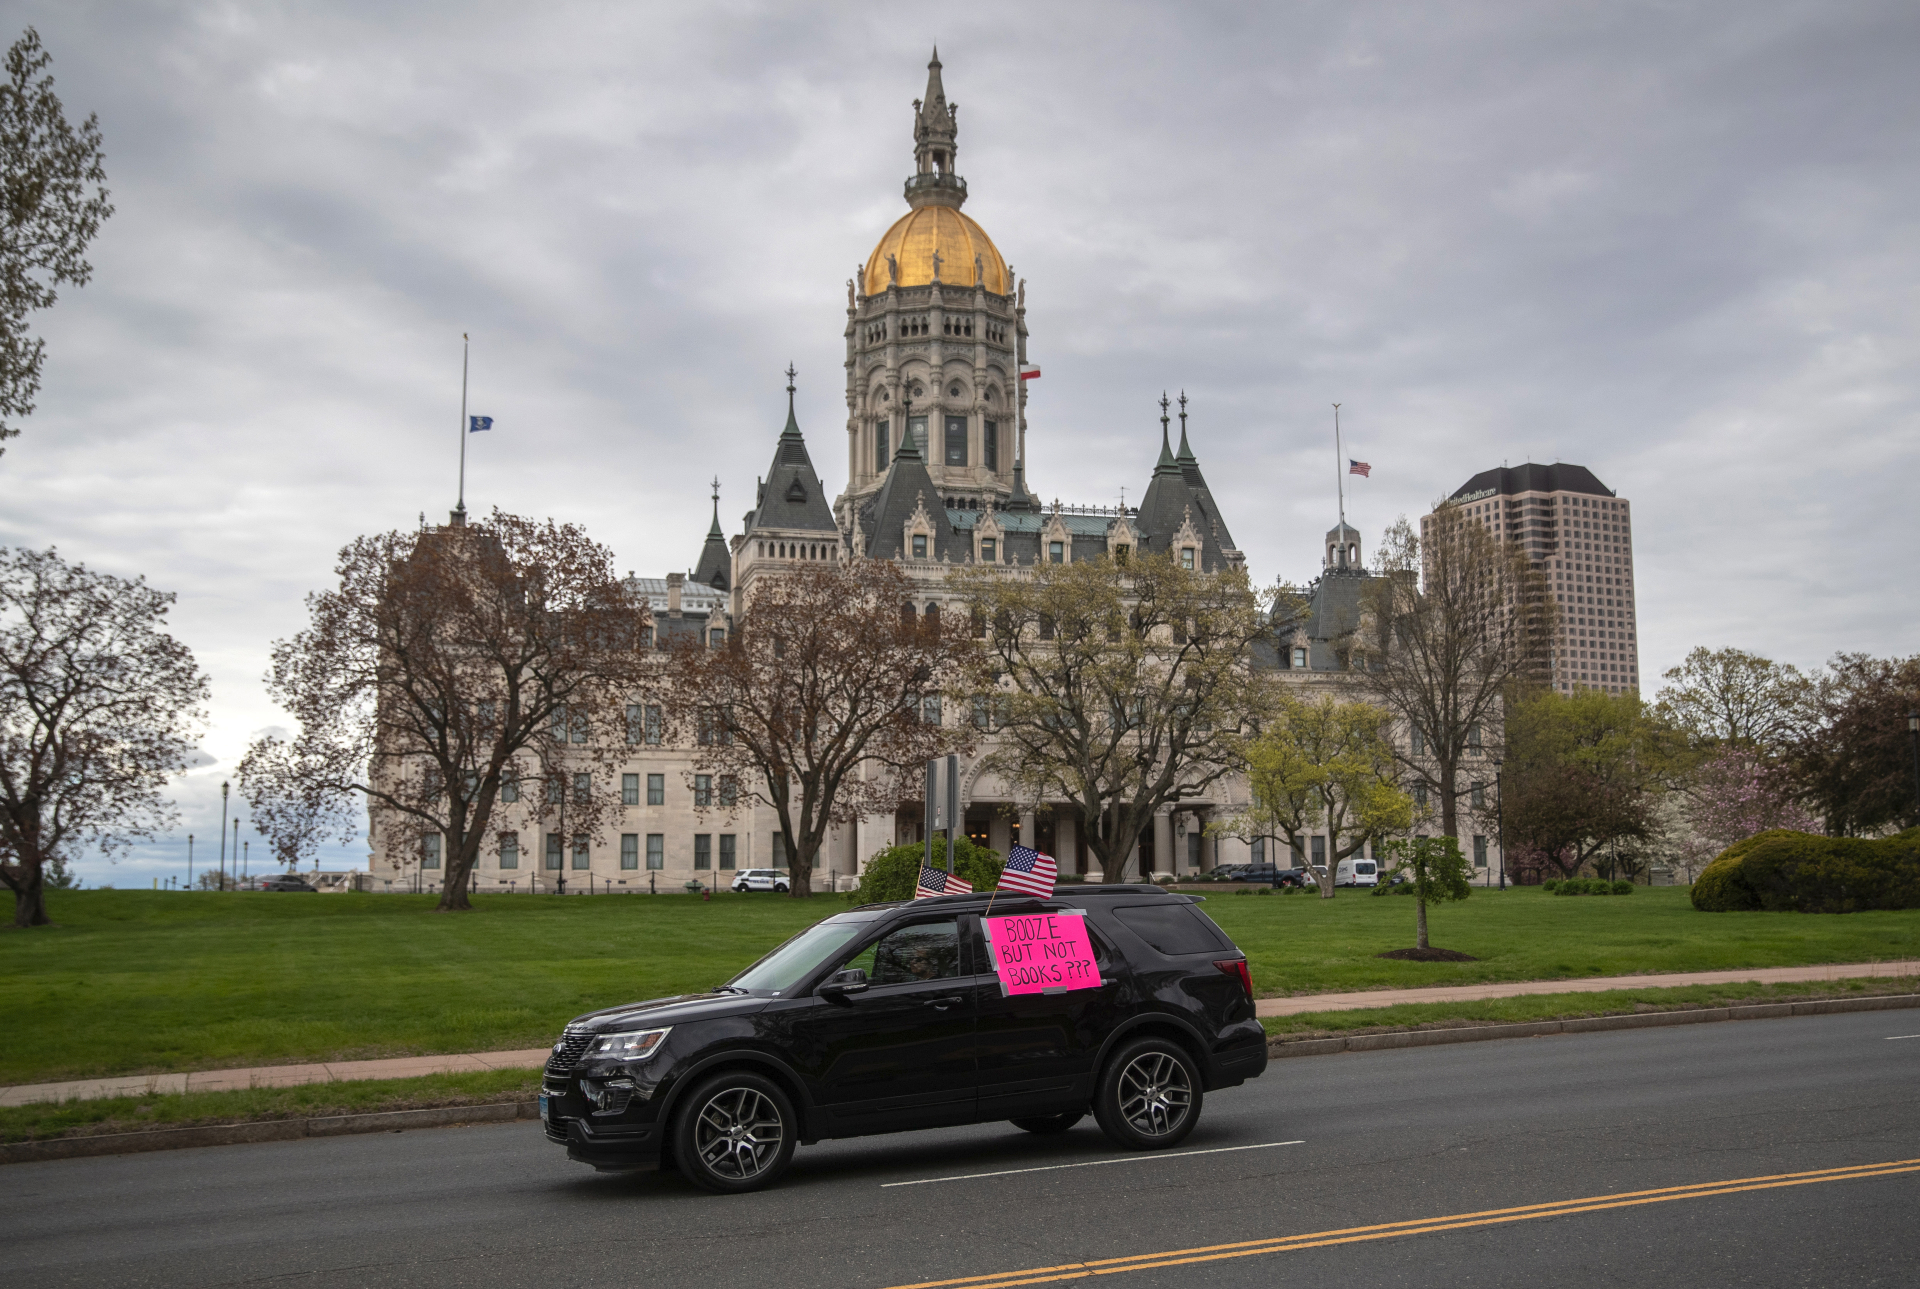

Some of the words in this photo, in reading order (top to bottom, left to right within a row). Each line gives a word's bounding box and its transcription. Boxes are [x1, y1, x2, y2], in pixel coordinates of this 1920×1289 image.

[1004, 917, 1061, 942] BOOZE
[1001, 943, 1032, 964] BUT
[1044, 941, 1077, 959] NOT
